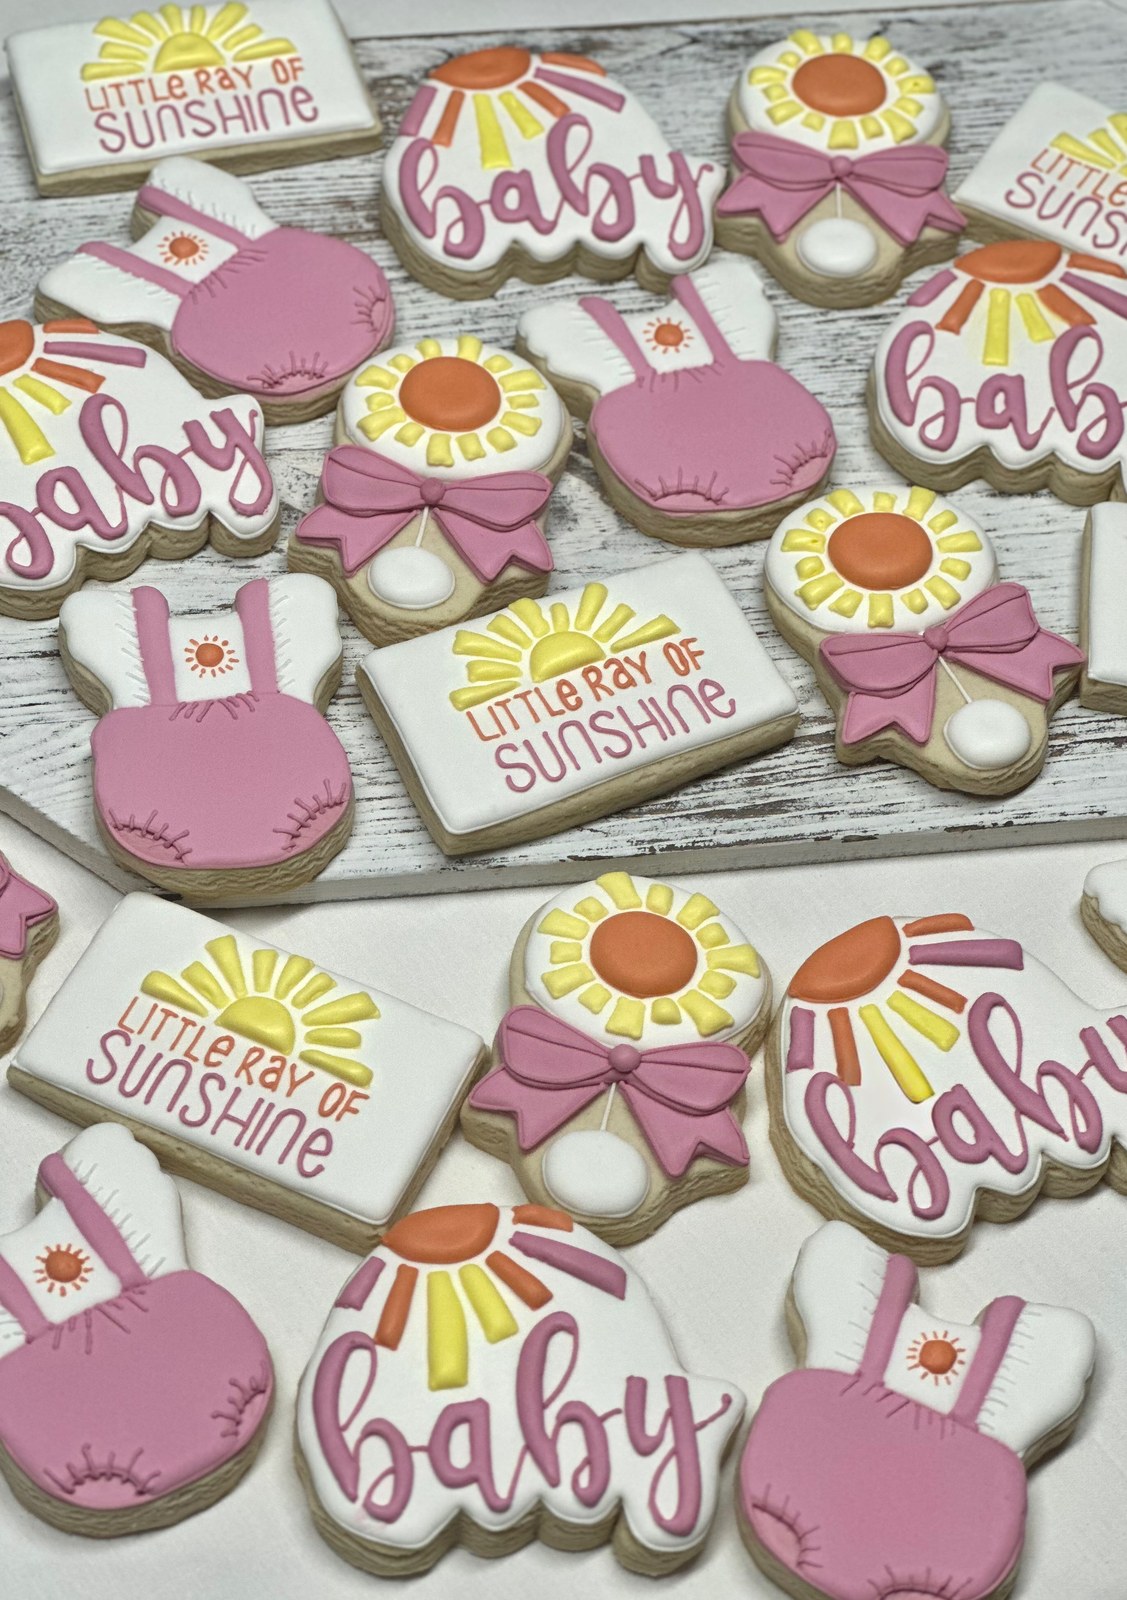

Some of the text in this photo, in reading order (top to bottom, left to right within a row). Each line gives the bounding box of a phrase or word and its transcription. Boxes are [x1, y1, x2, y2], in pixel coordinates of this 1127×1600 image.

[270, 57, 304, 84] OF
[398, 112, 714, 261] baby
[884, 320, 1127, 461] bab
[662, 637, 705, 677] OF
[317, 1082, 370, 1122] OF
[312, 1311, 733, 1537] baby
